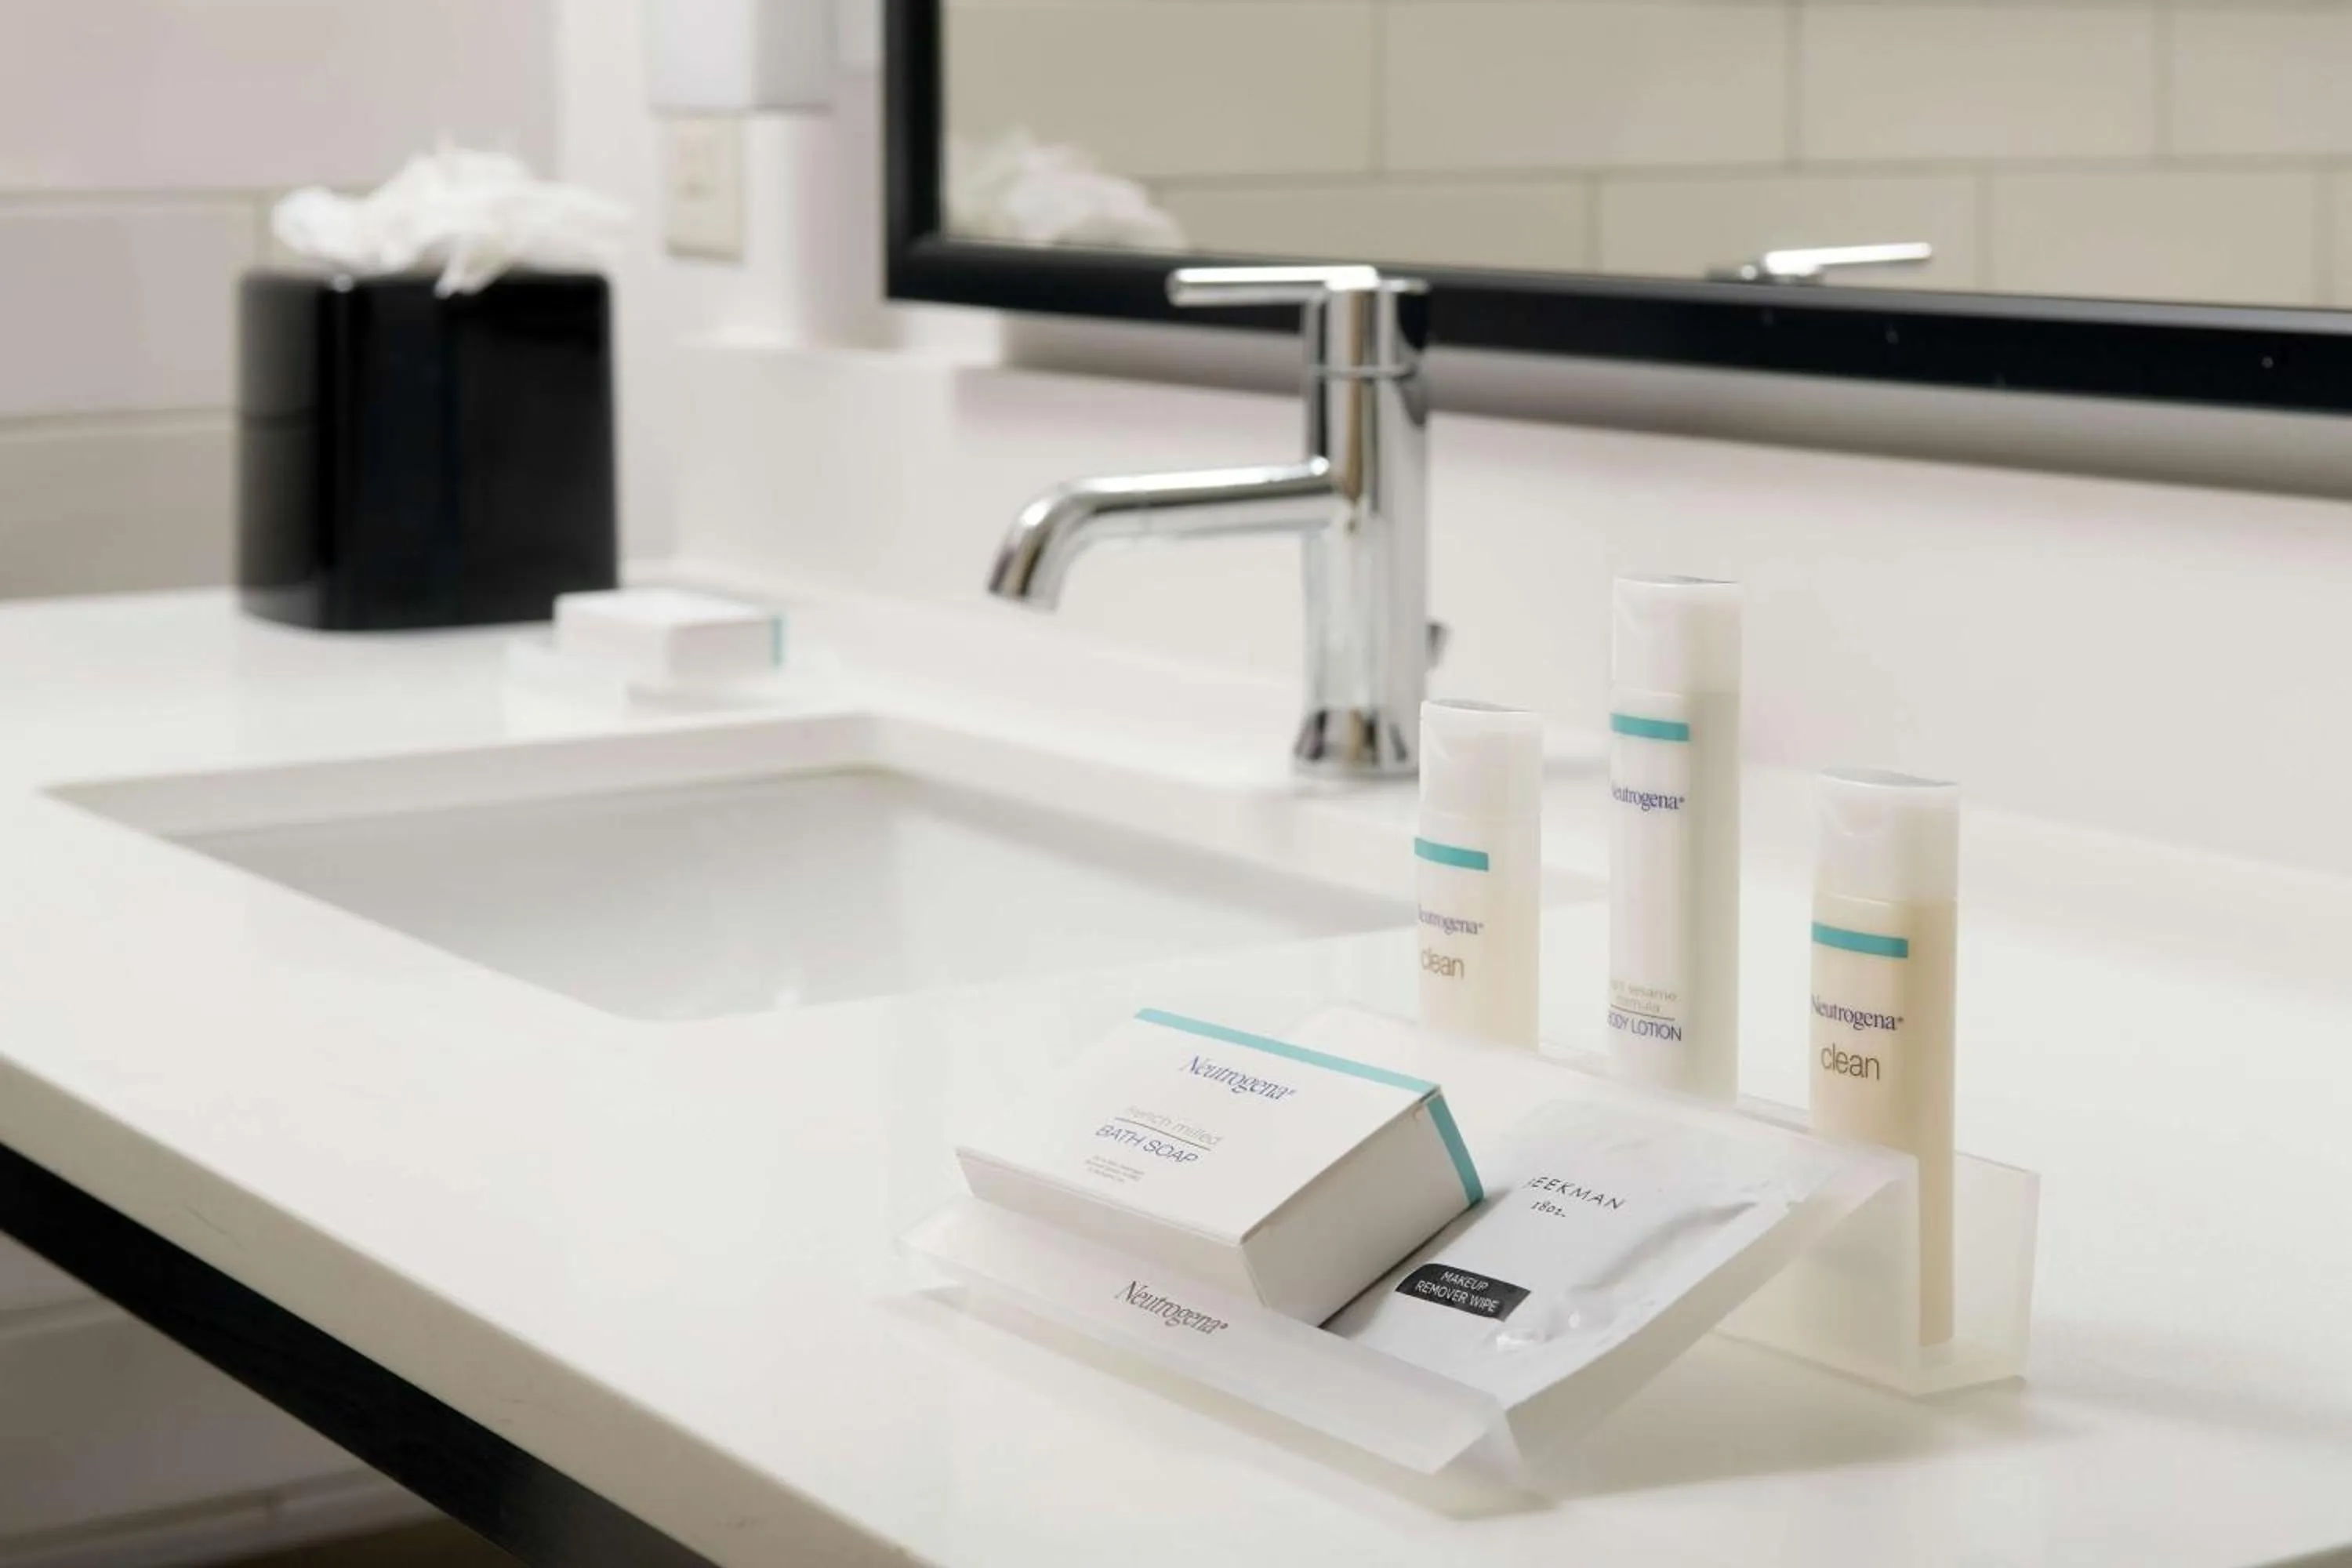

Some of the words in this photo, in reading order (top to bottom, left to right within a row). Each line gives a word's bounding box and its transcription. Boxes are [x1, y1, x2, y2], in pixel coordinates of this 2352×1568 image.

[1611, 780, 1679, 812] eutrogena
[1421, 947, 1465, 979] clean
[1811, 993, 1897, 1031] Neutrogena
[1632, 1019, 1682, 1042] LOTION
[1179, 1055, 1290, 1100] Neutrogena
[1820, 1042, 1880, 1081] clean
[1095, 1124, 1148, 1146] BATH
[1142, 1139, 1199, 1163] SOAP
[1415, 1280, 1468, 1304] REMOVER
[1469, 1294, 1501, 1313] WIPE
[1440, 1271, 1490, 1291] MAKEUP
[1114, 1280, 1221, 1334] Neutrogena
